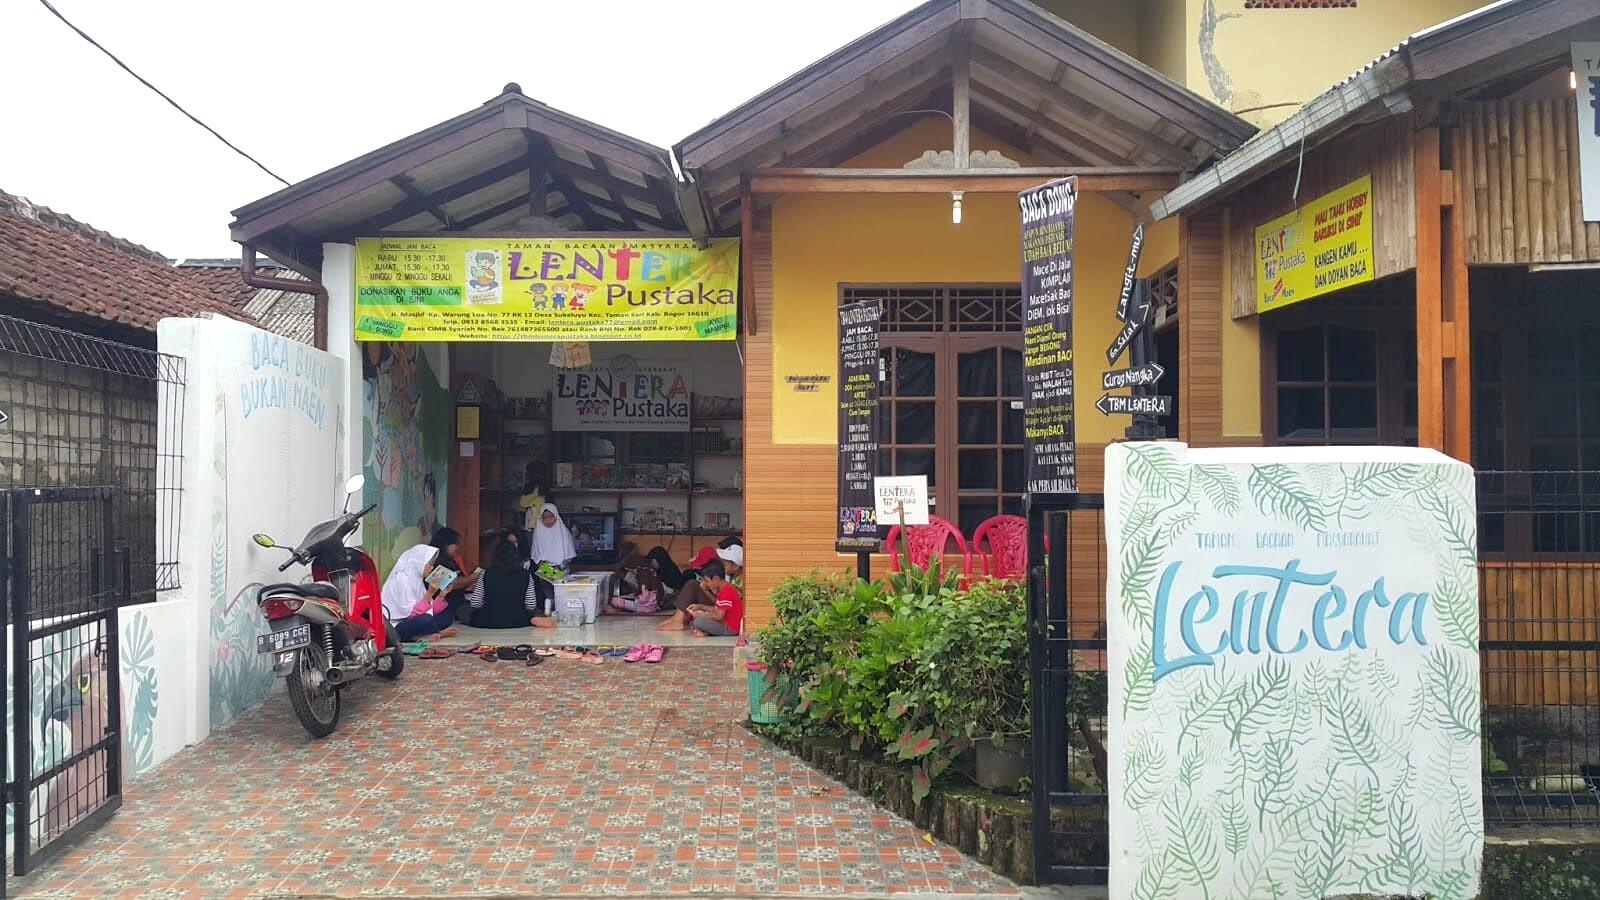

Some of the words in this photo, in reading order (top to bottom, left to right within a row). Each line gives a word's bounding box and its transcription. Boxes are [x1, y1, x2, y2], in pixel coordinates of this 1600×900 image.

[1020, 191, 1047, 224] BACA
[1047, 182, 1074, 216] DONG
[1261, 228, 1304, 260] LENT
[1314, 248, 1337, 268] KANGEN
[1339, 240, 1356, 260] KAMU
[508, 244, 735, 282] LENTERA
[1280, 248, 1305, 270] Pustaka
[1315, 272, 1326, 288] DAN
[1350, 259, 1367, 278] BACA
[360, 288, 405, 296] DONASIKAN
[411, 288, 432, 296] BUKU
[606, 282, 735, 306] Pustaka
[251, 333, 289, 372] BACA
[296, 346, 326, 390] BUKU
[1057, 349, 1072, 362] BAC
[240, 376, 287, 418] BUKAN
[294, 380, 326, 430] MAEN
[613, 398, 688, 417] Pustaka
[1108, 398, 1126, 411] TBM
[1128, 396, 1165, 412] LENTERA
[880, 487, 916, 496] LENTERA
[841, 507, 876, 522] LENTERA
[1195, 532, 1234, 549] TAMAN
[1256, 532, 1294, 549] BACAAN
[1152, 558, 1429, 684] Lentera
[270, 631, 289, 643] 6089
[279, 652, 293, 664] 12
